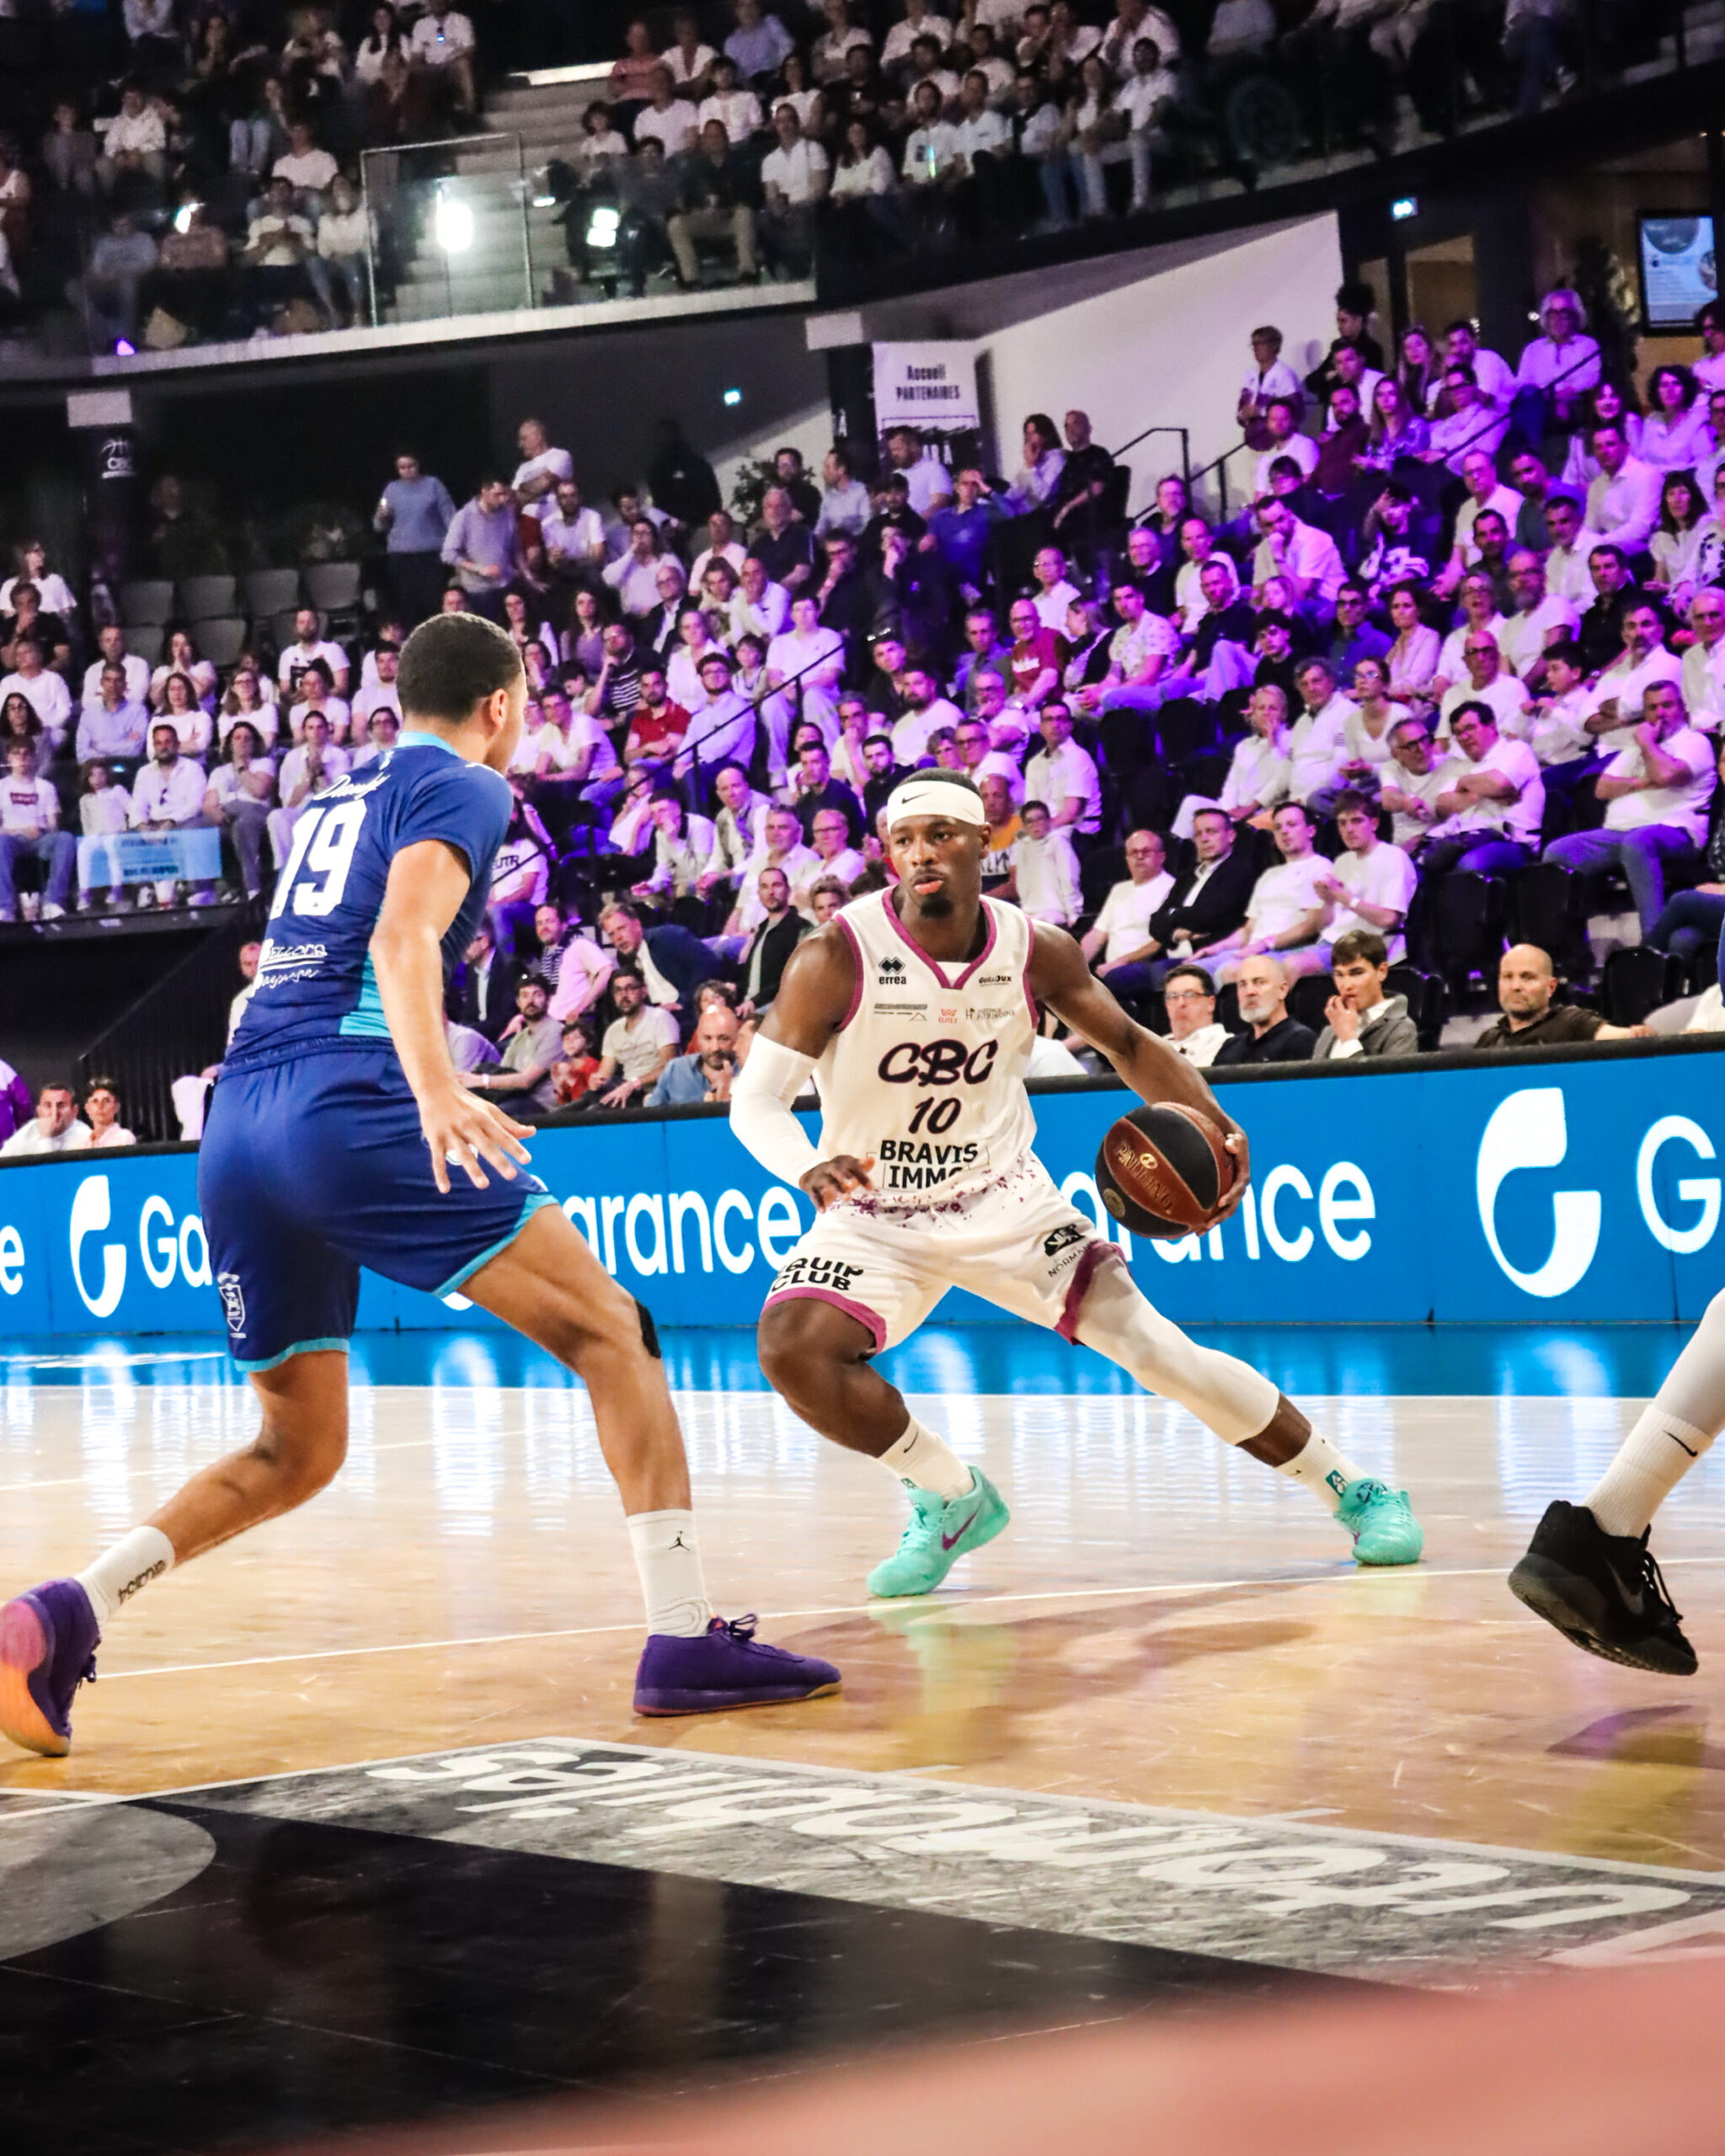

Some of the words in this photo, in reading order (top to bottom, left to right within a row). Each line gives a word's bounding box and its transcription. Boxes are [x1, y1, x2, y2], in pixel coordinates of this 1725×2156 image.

[896, 386, 960, 400] PARTENAIRES
[270, 798, 366, 920] 19
[878, 1038, 999, 1086] CBC
[908, 1097, 962, 1134] 10
[879, 1139, 979, 1166] BRAVIS
[1636, 1114, 1722, 1254] G
[531, 1174, 802, 1277] arance
[0, 1225, 25, 1295] e
[772, 1269, 852, 1291] CLUB
[779, 1257, 864, 1278] QUIP
